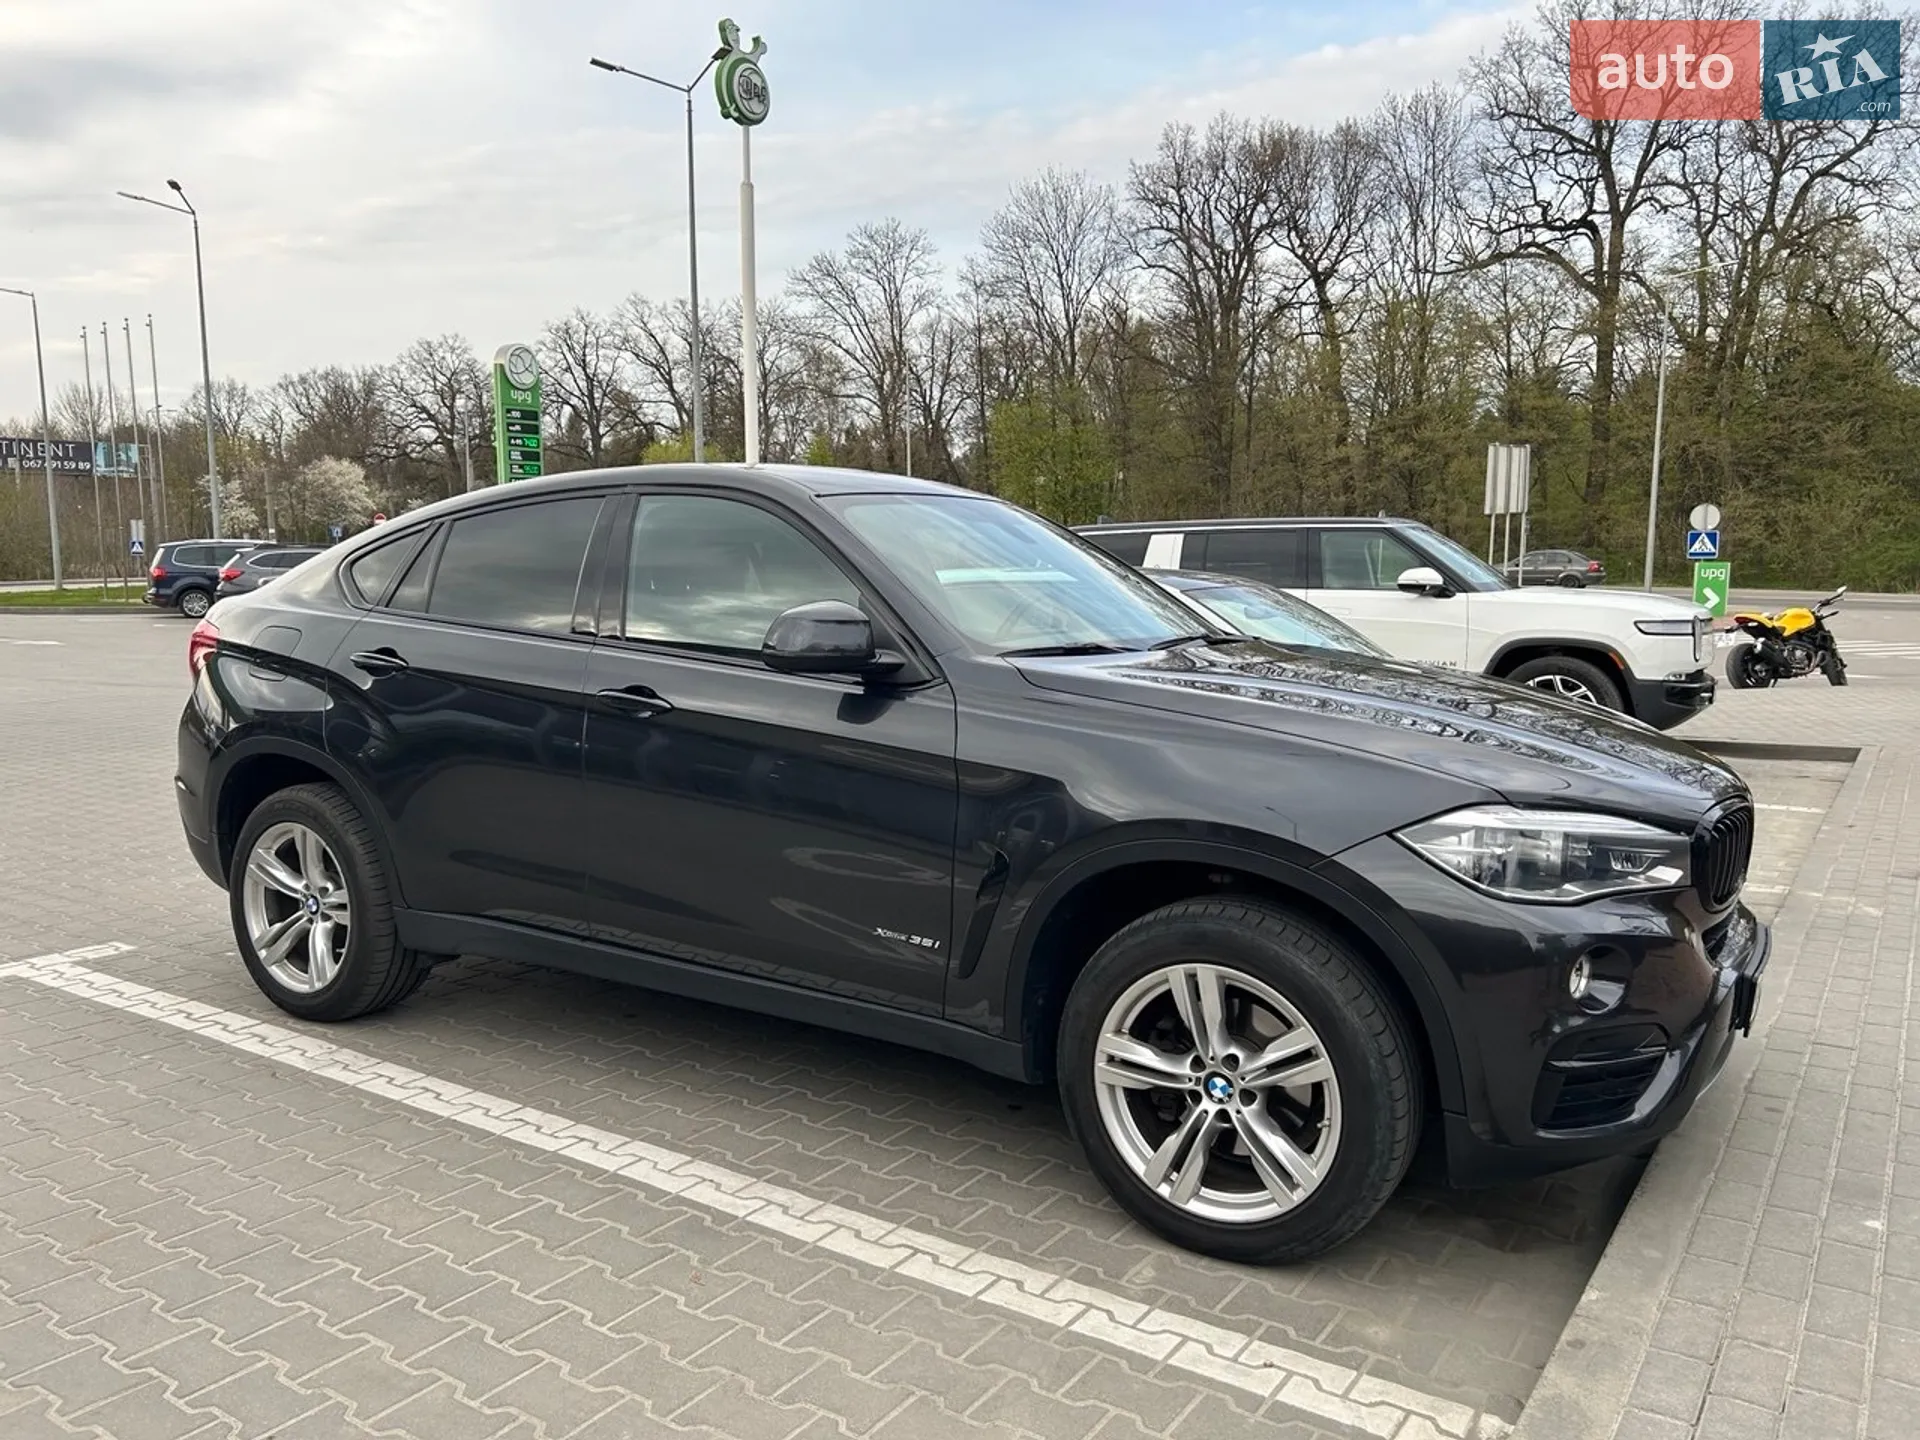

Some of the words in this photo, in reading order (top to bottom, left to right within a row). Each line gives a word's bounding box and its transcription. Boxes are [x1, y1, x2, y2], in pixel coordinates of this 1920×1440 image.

[510, 389, 532, 403] upg
[22, 459, 42, 468] 067
[1700, 567, 1726, 581] upg
